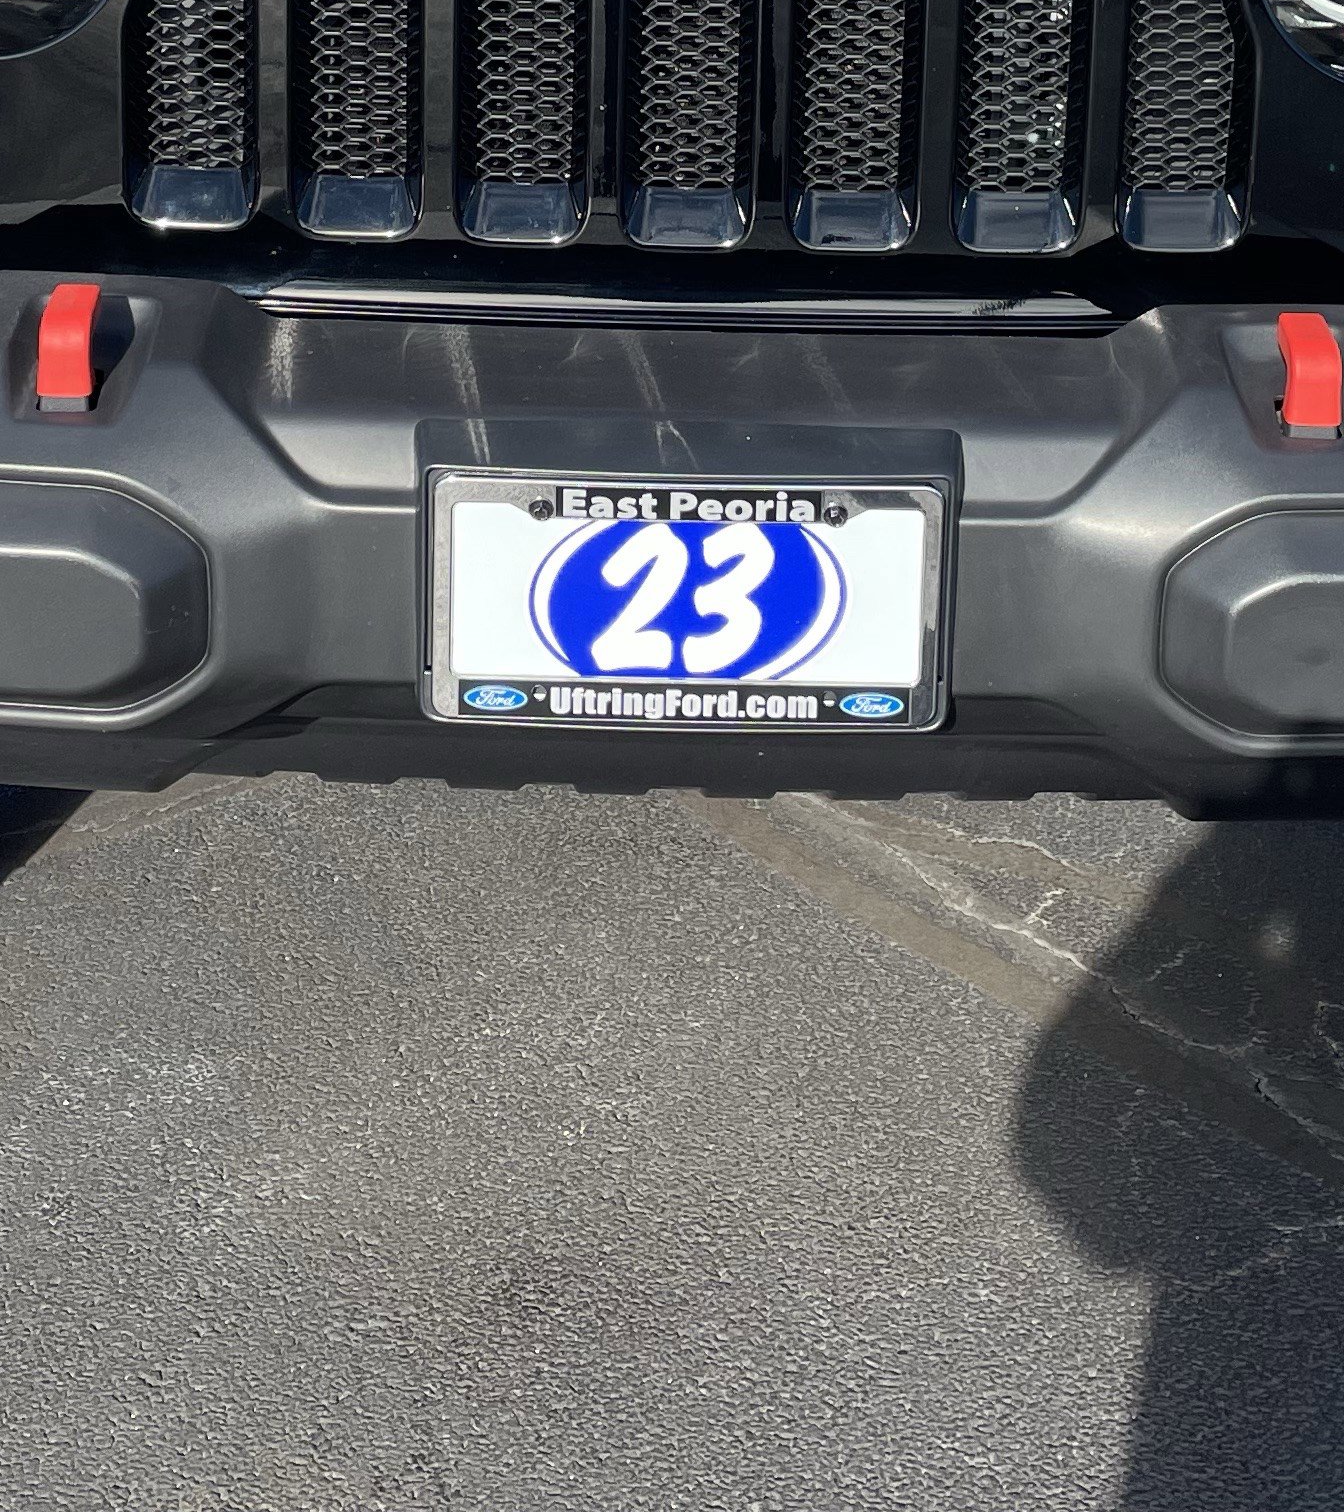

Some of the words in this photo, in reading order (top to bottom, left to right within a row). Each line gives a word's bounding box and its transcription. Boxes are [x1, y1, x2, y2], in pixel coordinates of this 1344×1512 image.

[562, 489, 658, 520] East
[669, 491, 816, 522] Peoria
[590, 521, 776, 675] 23
[475, 689, 517, 706] Ford
[549, 686, 818, 719] UftringFord.com
[851, 696, 893, 713] Ford
